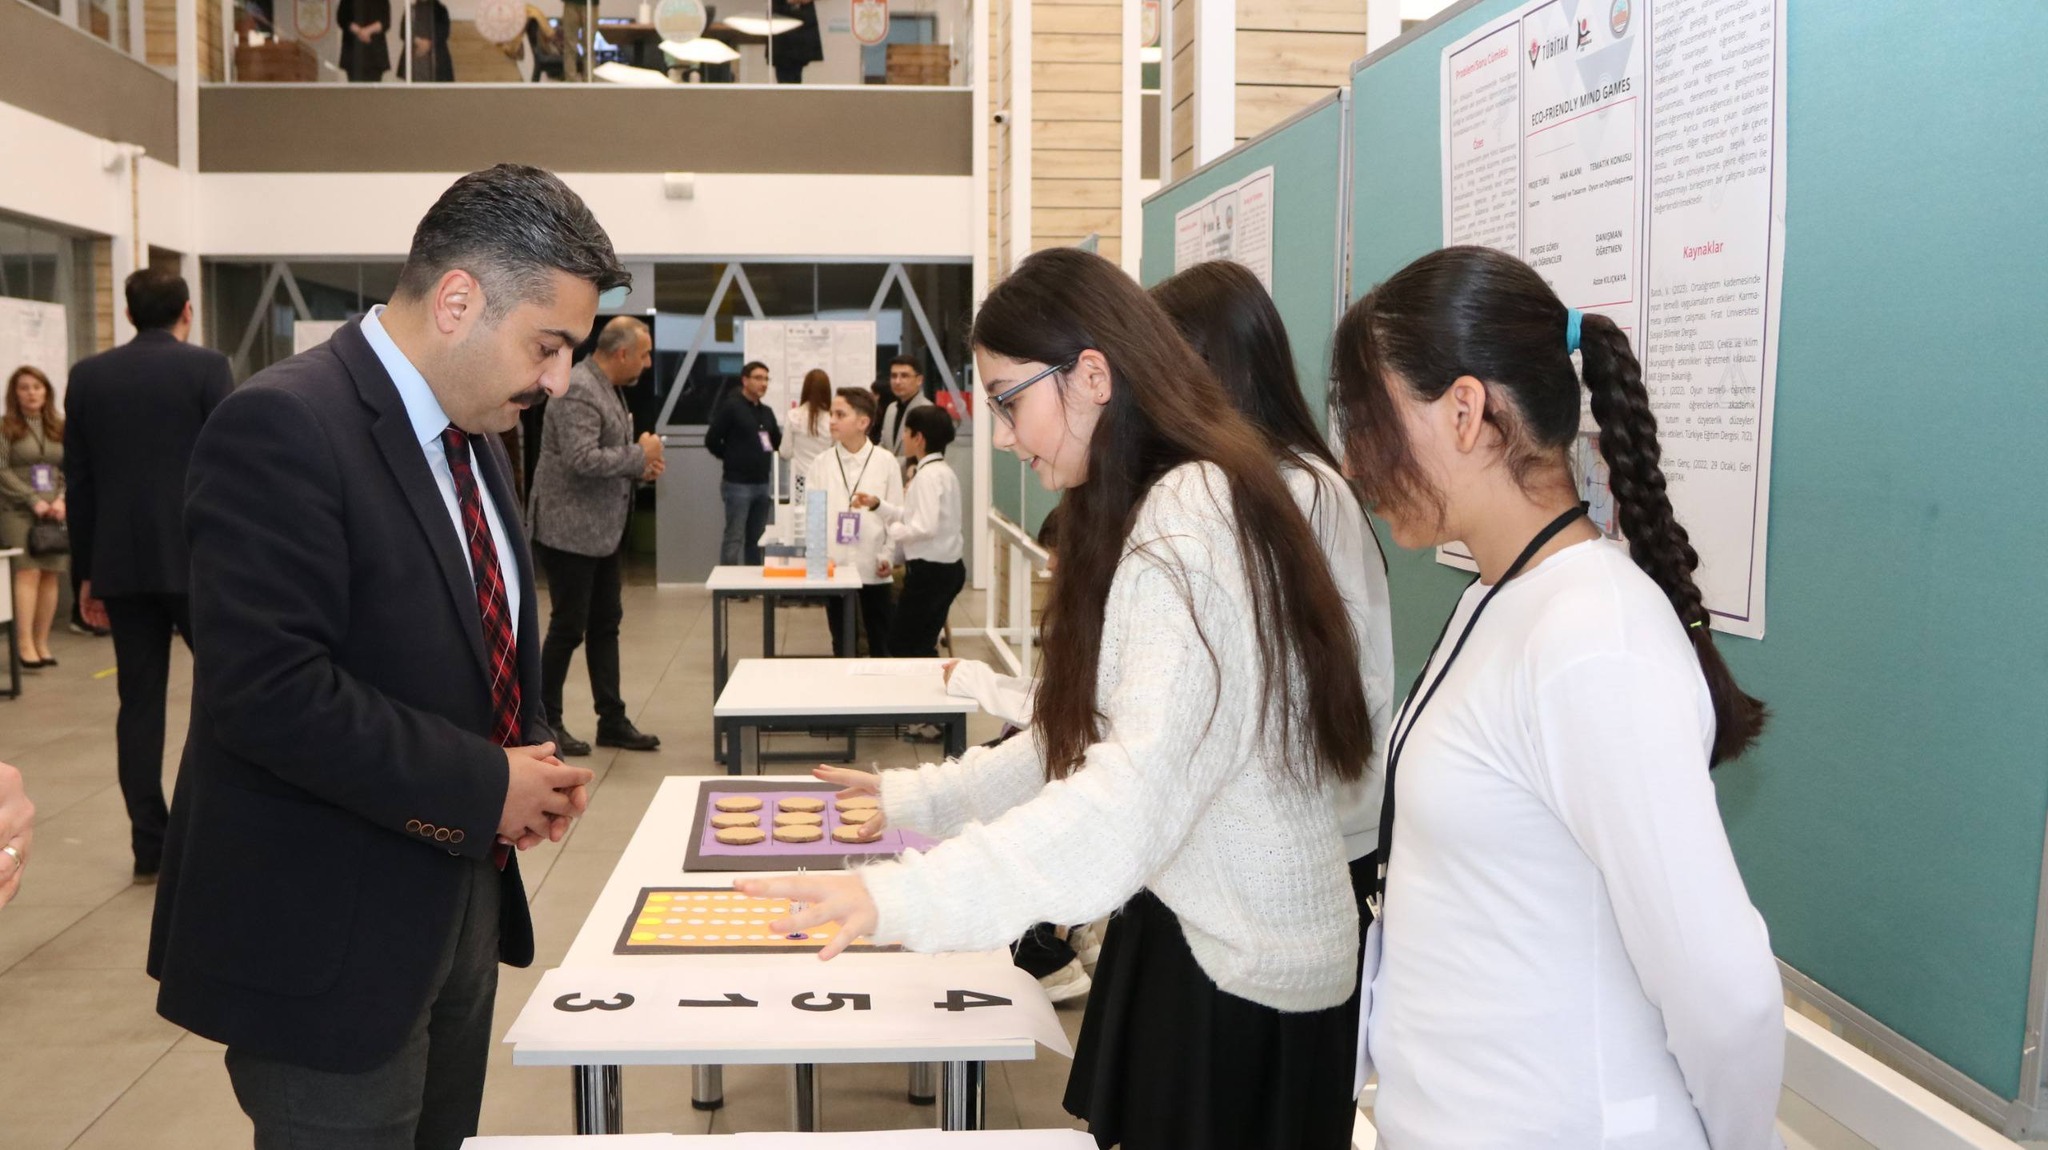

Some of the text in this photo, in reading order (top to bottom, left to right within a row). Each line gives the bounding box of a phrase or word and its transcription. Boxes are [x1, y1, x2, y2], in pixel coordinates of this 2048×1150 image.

[1542, 34, 1569, 60] TÜBİTAK
[1531, 77, 1631, 127] ECO-FRIENDLY MIND GAMES
[1683, 240, 1723, 260] Kaynaklar
[553, 992, 635, 1012] 3
[678, 993, 758, 1008] 1
[791, 991, 871, 1012] 5
[933, 990, 1013, 1012] 4
